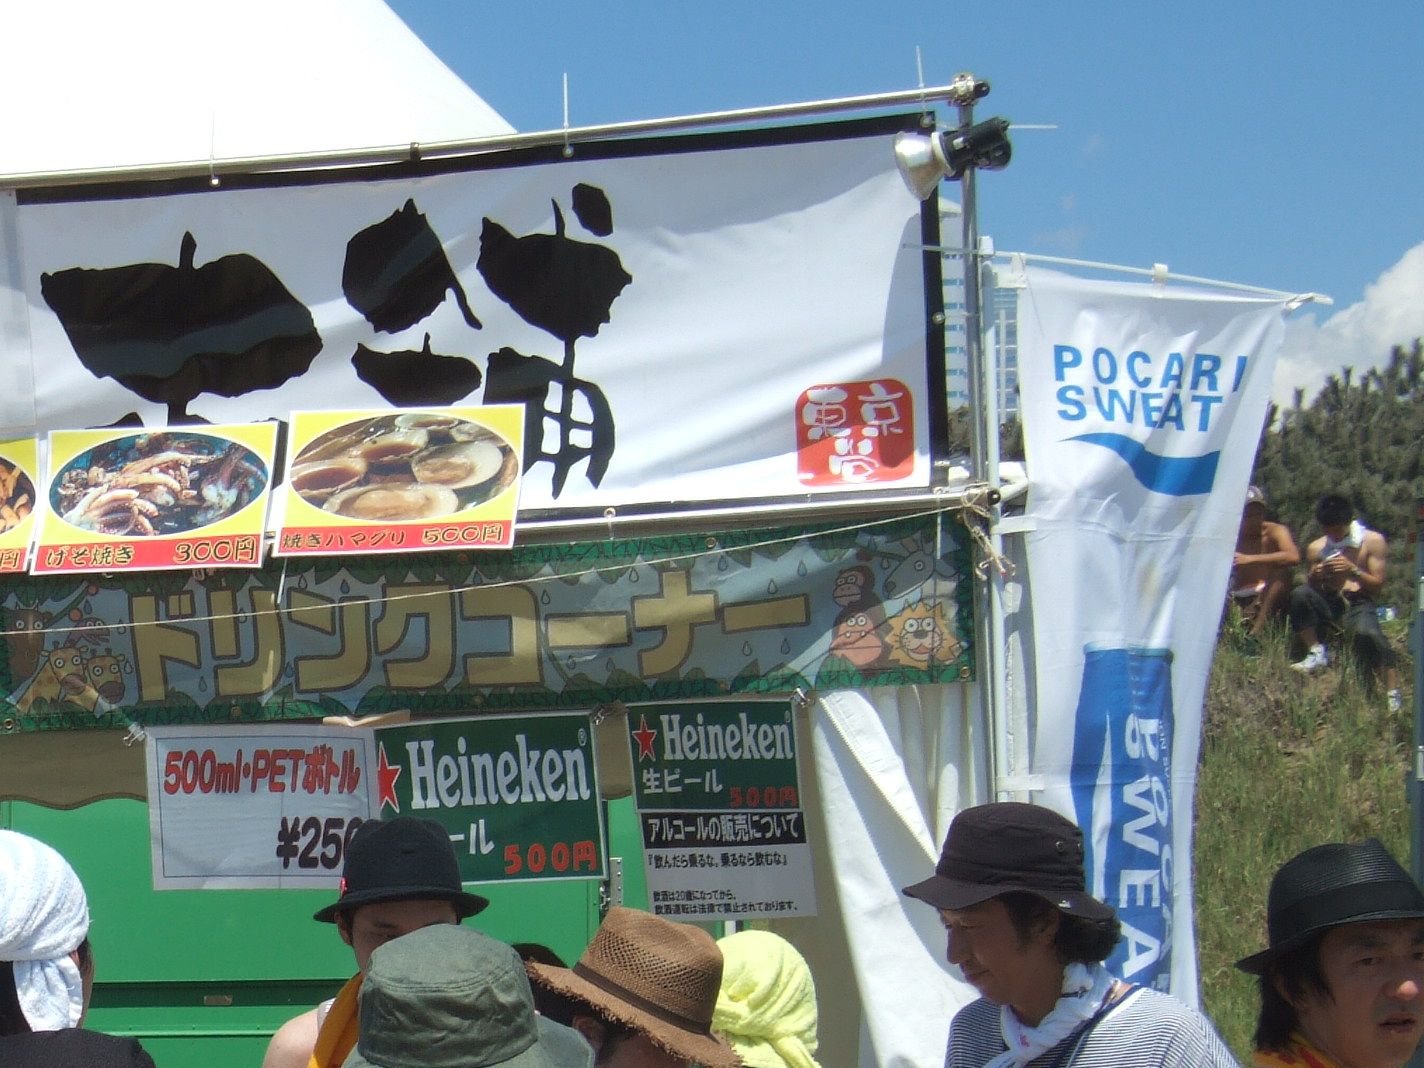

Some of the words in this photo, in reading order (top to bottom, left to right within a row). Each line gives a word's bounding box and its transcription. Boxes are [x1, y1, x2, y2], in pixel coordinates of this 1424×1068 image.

[1054, 345, 1248, 392] POCARI
[1056, 385, 1223, 431] SWEAT
[46, 544, 135, 567] げそ焼き
[174, 536, 256, 562] 300円
[424, 525, 502, 544] 500円
[131, 571, 810, 702] ドリンクコーナー
[660, 711, 794, 760] Heineken
[406, 735, 591, 810] Heineken
[642, 768, 723, 794] 生ビール
[648, 813, 799, 842] アルコールの販売について
[503, 840, 597, 874] 500円
